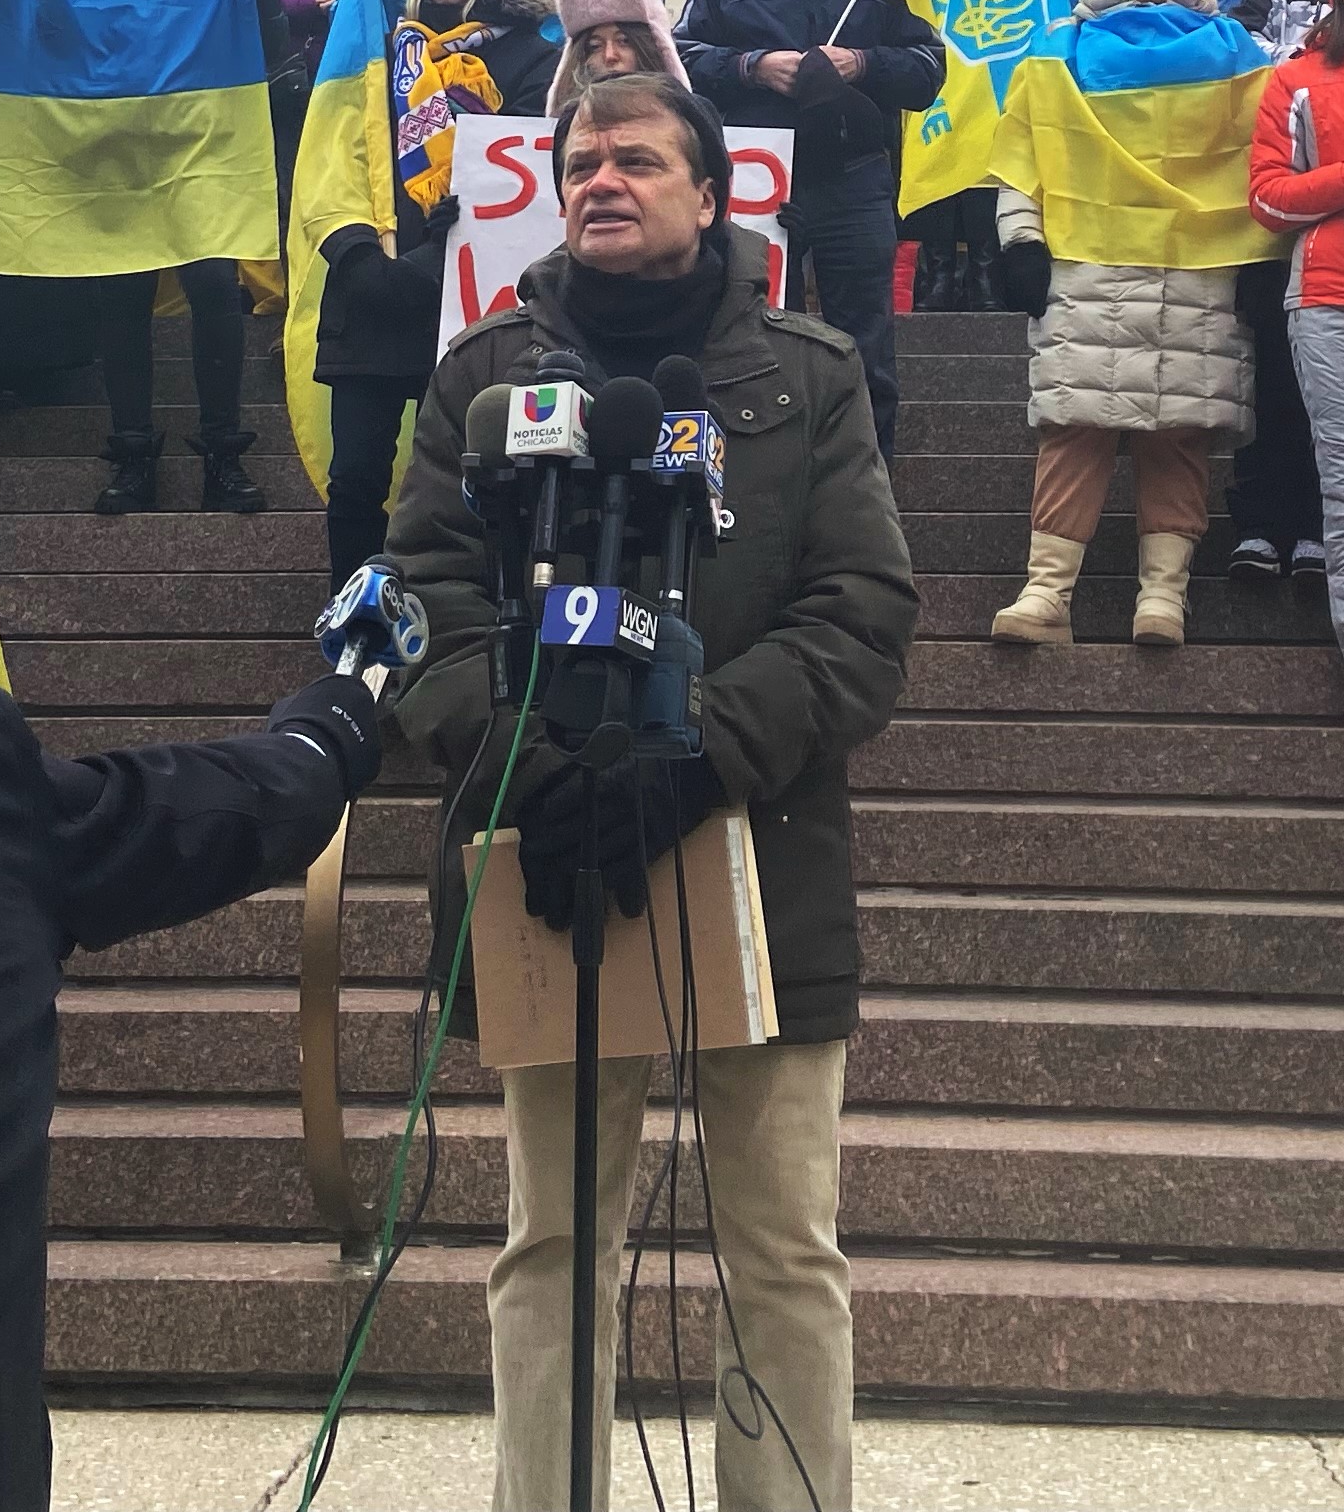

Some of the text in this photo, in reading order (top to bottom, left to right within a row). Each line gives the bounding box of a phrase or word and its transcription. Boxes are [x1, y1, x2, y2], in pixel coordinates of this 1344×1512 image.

[513, 426, 563, 440] NOTICIAS
[516, 435, 559, 448] CHICAGO
[652, 452, 698, 468] EWS
[564, 585, 600, 645] 9
[622, 599, 659, 640] WGN
